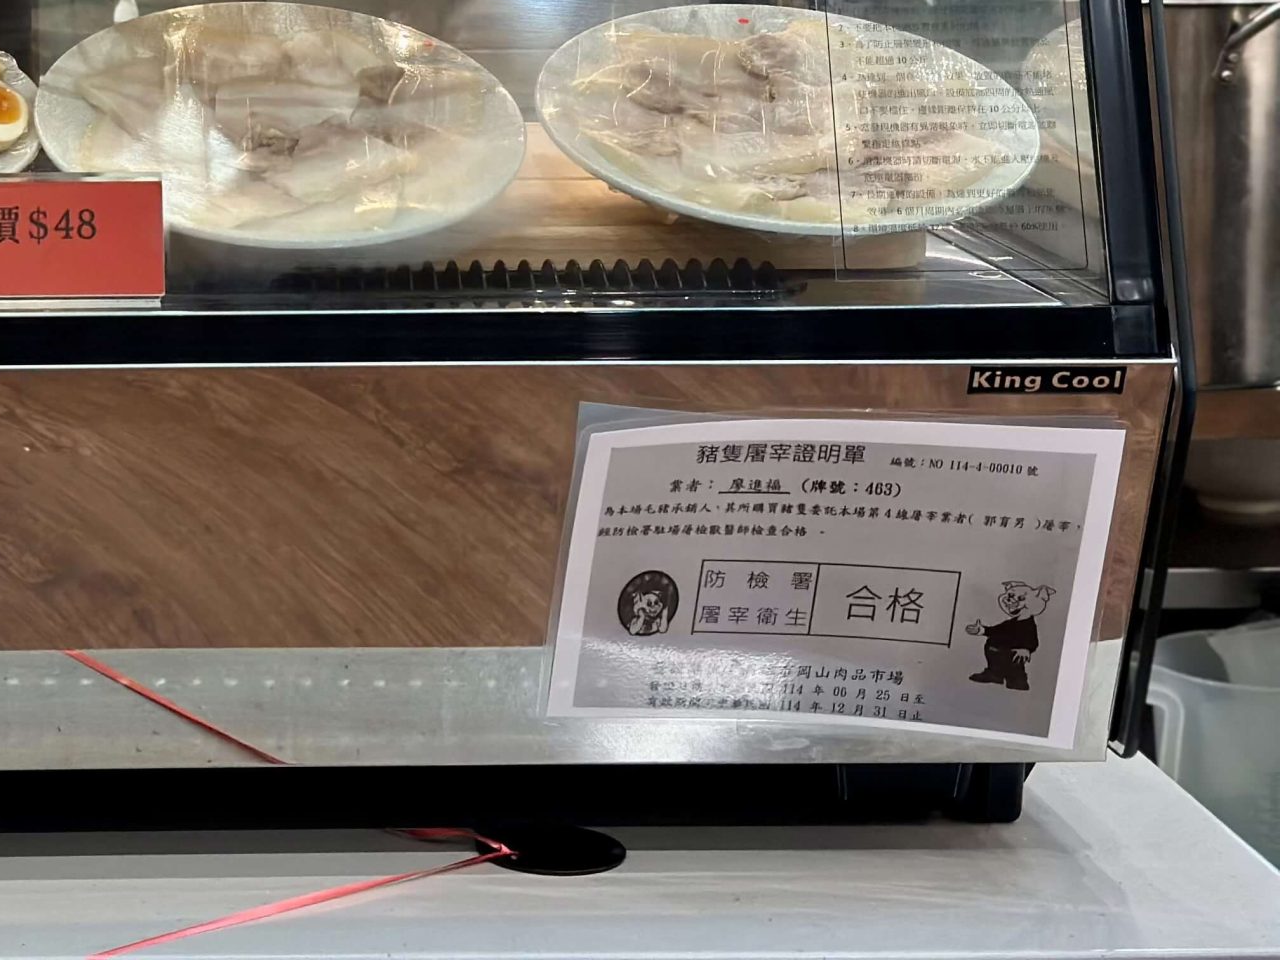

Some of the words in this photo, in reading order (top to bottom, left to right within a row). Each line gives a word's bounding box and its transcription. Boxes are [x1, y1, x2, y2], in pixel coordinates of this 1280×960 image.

[971, 370, 1042, 393] King
[1050, 369, 1123, 391] Cool
[696, 443, 866, 465] 豬隻屠宰證明單
[845, 584, 925, 626] 合格
[876, 689, 891, 702] 25
[832, 702, 845, 715] 12
[873, 706, 887, 718] 31
